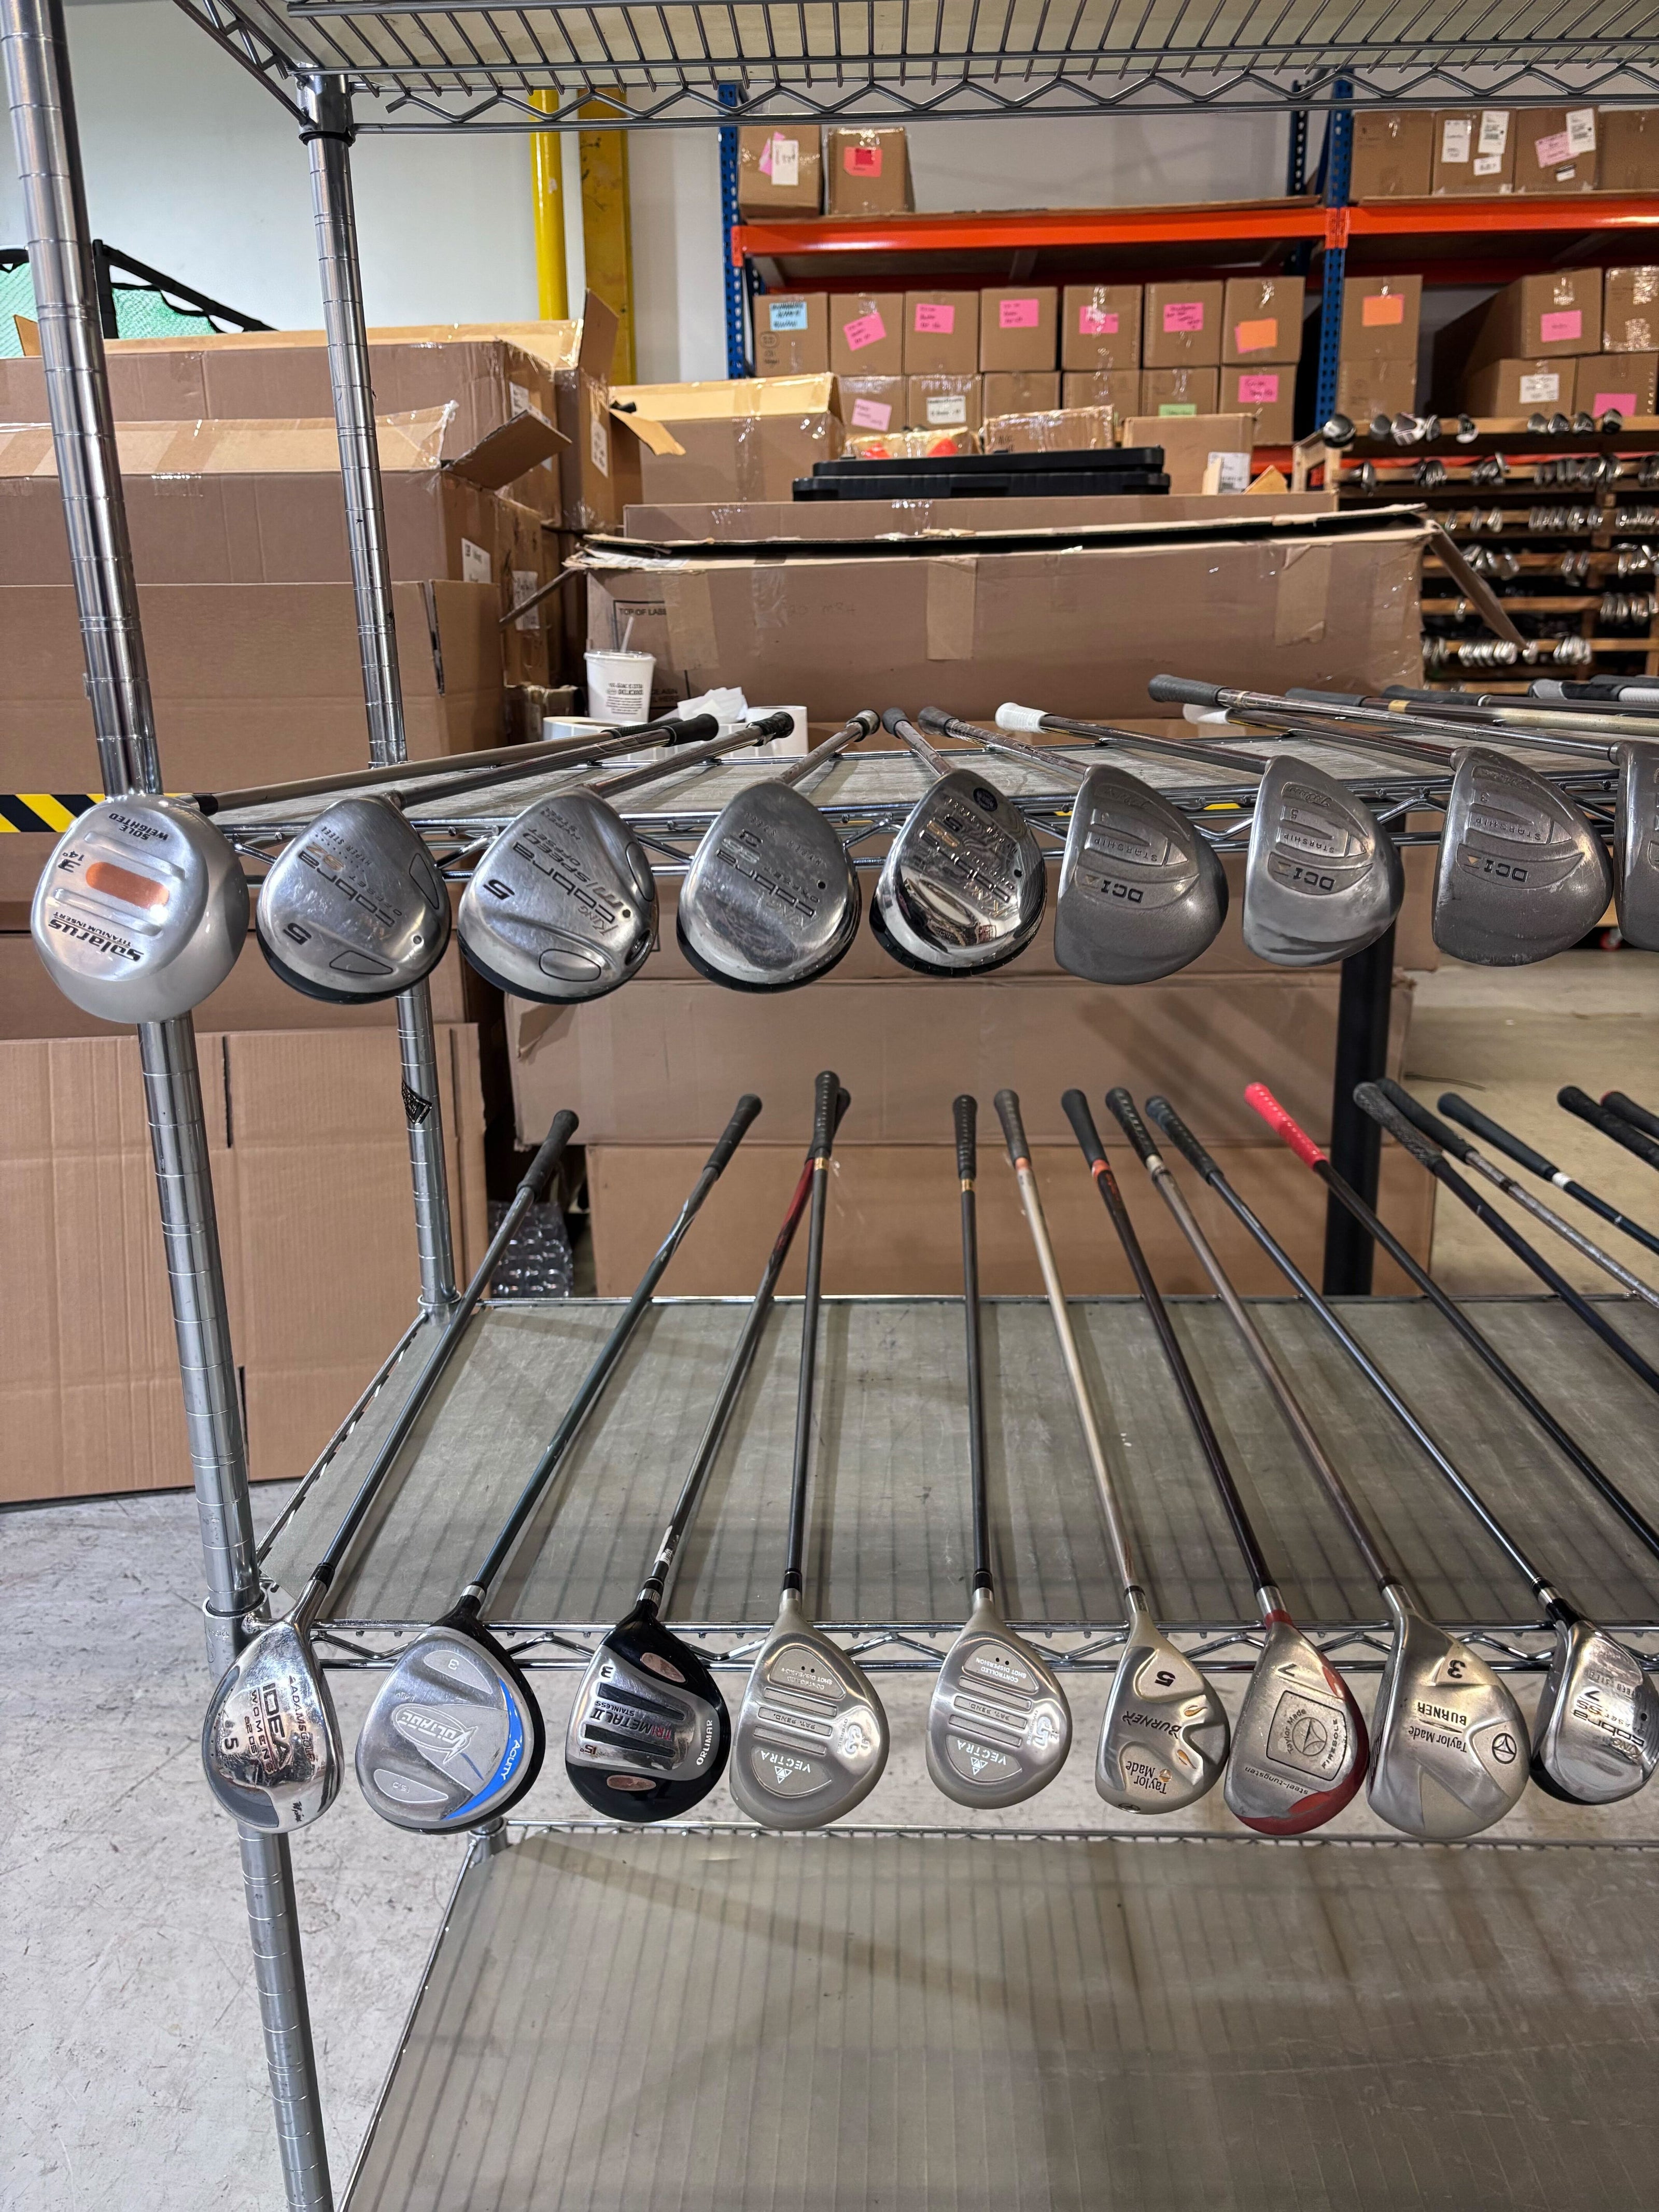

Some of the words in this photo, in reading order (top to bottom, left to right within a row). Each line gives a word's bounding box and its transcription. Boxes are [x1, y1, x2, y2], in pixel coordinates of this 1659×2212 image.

[1480, 792, 1490, 803] 3
[1290, 808, 1297, 819] 5
[109, 813, 168, 841] WEIGHTED
[119, 825, 151, 840] SOLE
[321, 826, 345, 848] STEEL
[1474, 817, 1541, 840] STARSHIP
[528, 827, 581, 865] OFFSET
[1094, 837, 1158, 862] STARSHIP
[1283, 833, 1334, 853] STARSHIP
[58, 859, 80, 873] 3
[345, 844, 372, 866] HYPER
[1484, 859, 1528, 883] DCI
[299, 850, 395, 927] cobra
[483, 879, 515, 901] 5
[513, 842, 615, 923] cobra
[715, 848, 817, 919] cobra
[1100, 880, 1144, 904] DCI
[349, 875, 402, 915] OFFSET
[53, 911, 87, 932] INSERT
[88, 924, 131, 947] TITANIUM
[283, 922, 312, 945] 5
[448, 1659, 459, 1670] 3
[600, 1666, 613, 1678] 3
[975, 1657, 1009, 1674] DISPERSION
[981, 1666, 1019, 1683] CONTROLLED
[1447, 1659, 1466, 1679] 3
[814, 1675, 833, 1685] SHOT
[1155, 1670, 1176, 1687] 5
[595, 1701, 635, 1716] STAINLESS
[1287, 1708, 1307, 1725] Made
[1416, 1702, 1467, 1726] BURNER
[250, 1690, 276, 1773] WOMENS
[262, 1683, 292, 1769] IDEA
[1122, 1711, 1182, 1739] BURNER
[1408, 1726, 1436, 1742] Made
[1573, 1709, 1645, 1746] cobra
[224, 1738, 239, 1750] 5
[1283, 1724, 1294, 1754] Taylor
[1321, 1718, 1338, 1770] FIRESOLE
[1436, 1734, 1468, 1753] Taylor
[500, 1740, 521, 1780] ACUITY
[761, 1750, 811, 1773] VECTRA
[958, 1739, 1007, 1765] VECTRA
[1126, 1760, 1156, 1776] Made
[1134, 1774, 1167, 1794] Taylor
[1244, 1766, 1309, 1795] steel-tungsten
